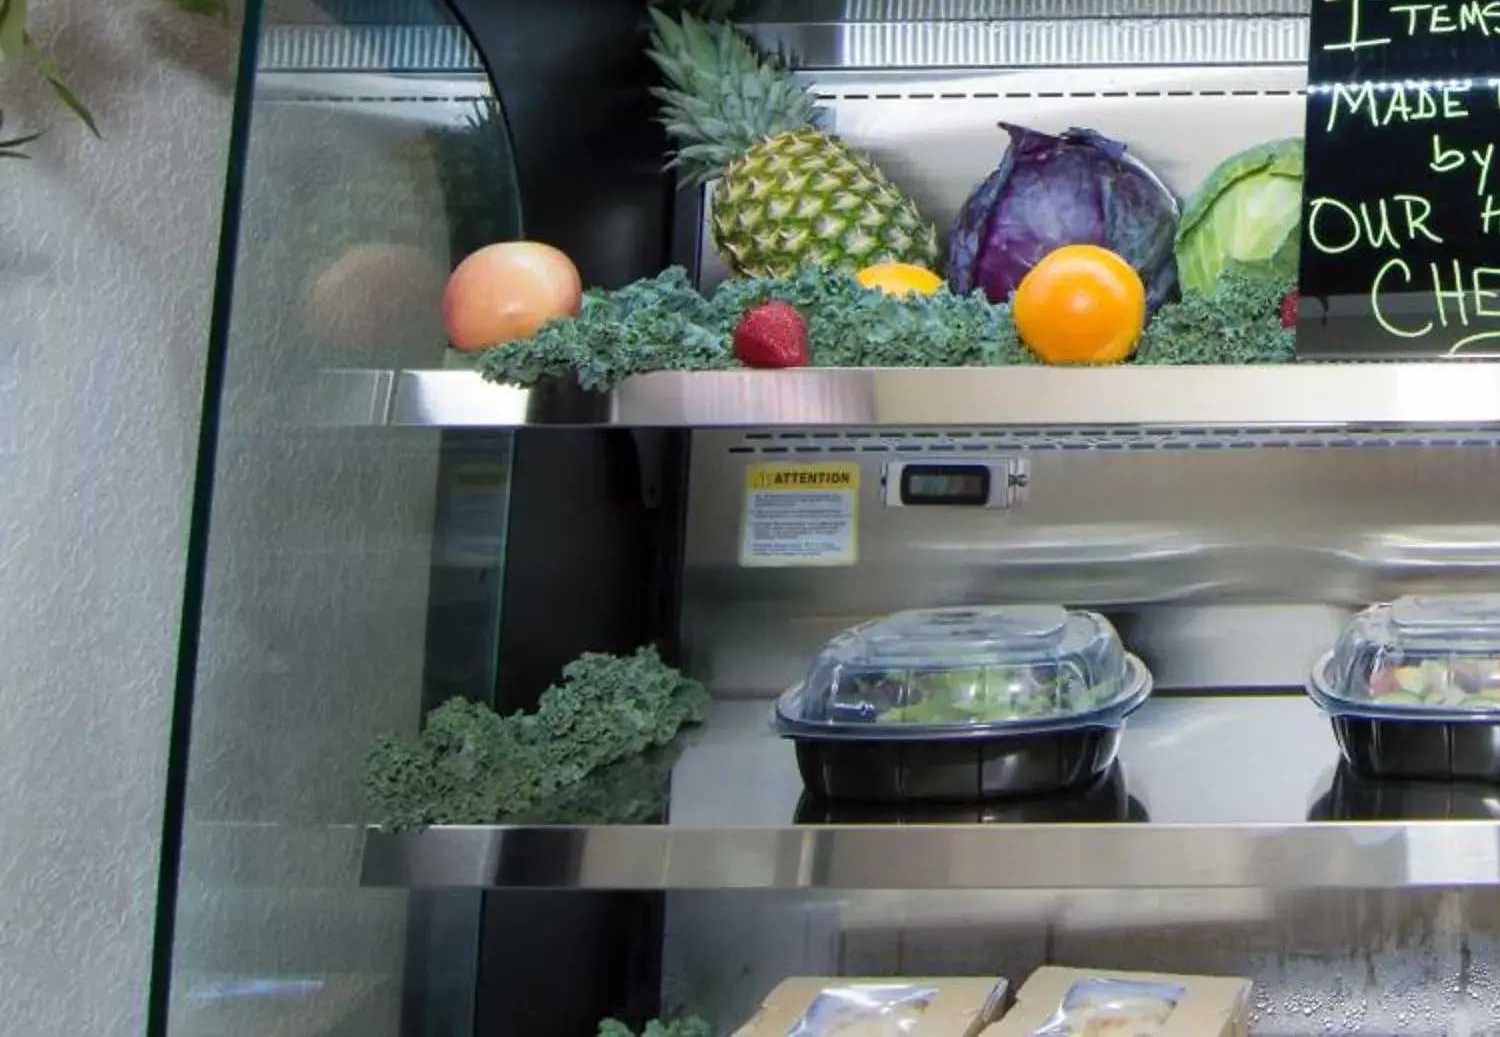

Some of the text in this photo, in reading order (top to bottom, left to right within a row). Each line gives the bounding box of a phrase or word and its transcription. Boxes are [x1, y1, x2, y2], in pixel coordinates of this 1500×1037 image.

[1327, 80, 1469, 131] MADE
[1430, 135, 1494, 195] by
[1309, 195, 1443, 253] OUR
[774, 472, 850, 484] ATTENTION
